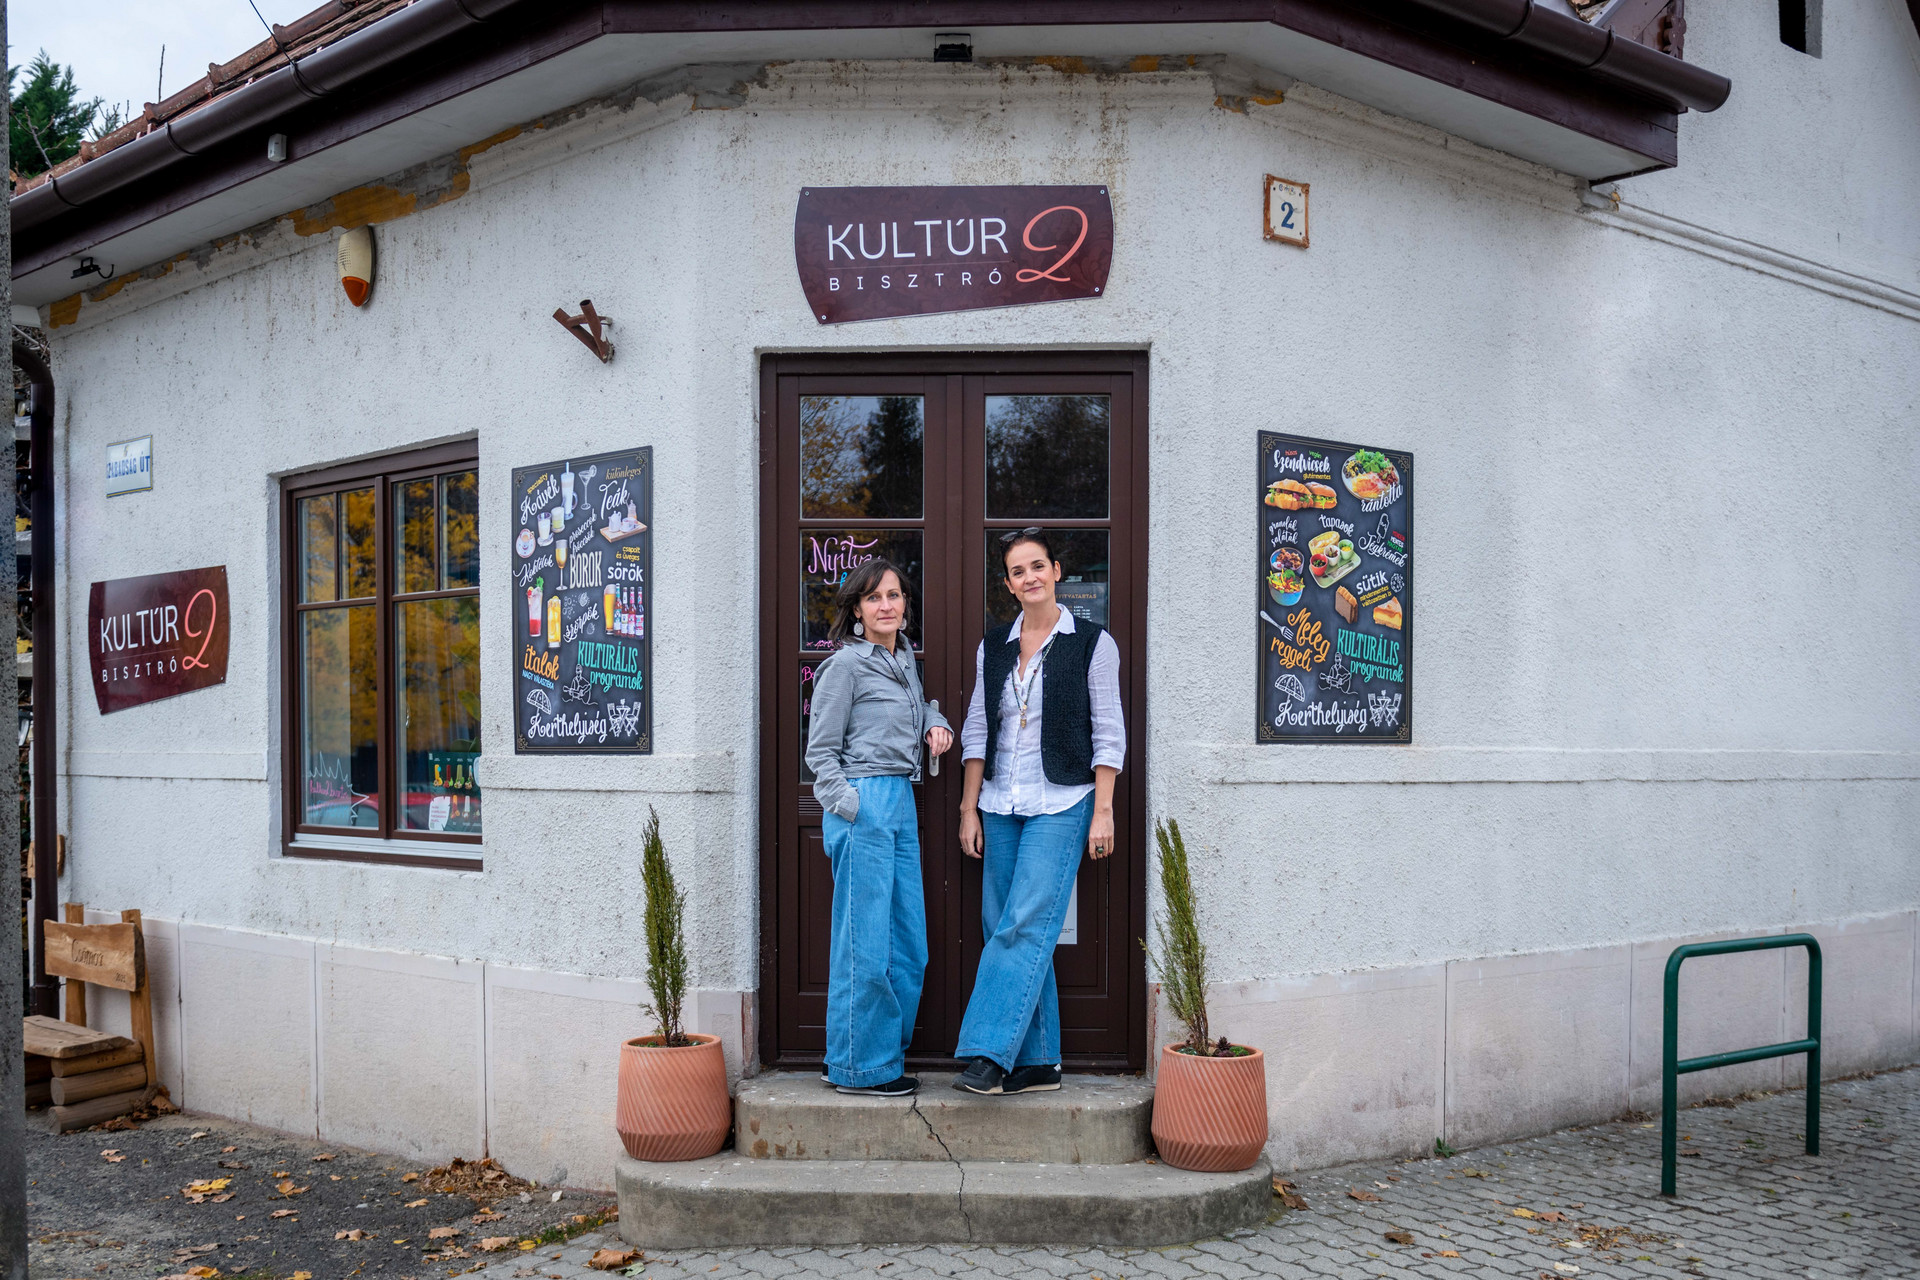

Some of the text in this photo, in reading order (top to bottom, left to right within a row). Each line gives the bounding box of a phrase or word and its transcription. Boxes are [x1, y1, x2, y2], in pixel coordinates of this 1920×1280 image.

[1281, 201, 1295, 230] 2
[827, 205, 1089, 284] KULTÚR 2
[828, 267, 1002, 292] BISZTRÓ
[139, 451, 151, 473] ÚT
[605, 465, 642, 481] különleges
[1273, 449, 1331, 474] Szendvicsek
[520, 473, 560, 526] Kávék
[598, 478, 631, 520] Teák
[1360, 482, 1404, 513] rántotta
[1268, 516, 1298, 535] granolák
[1271, 530, 1299, 548] saláták
[1318, 514, 1355, 537] tapasok
[1358, 532, 1408, 568] Jégkrémek
[512, 554, 554, 588] Koktélok
[569, 550, 603, 590] BOROK
[607, 561, 644, 582] sörök
[1356, 570, 1389, 595] sütik
[100, 588, 217, 671] KULTÚR 2
[562, 602, 600, 644] szörpök
[1287, 607, 1331, 664] Meleg
[523, 643, 560, 681] italok
[577, 640, 638, 674] KULTURÁLIS
[1270, 636, 1313, 673] reggeli
[1336, 628, 1400, 667] KULTURÁLIS
[102, 654, 177, 683] BISZTRÓ
[589, 670, 644, 693] programok
[1349, 660, 1404, 683] programok
[527, 710, 608, 744] Kerthelyiség
[1274, 699, 1368, 734] Kerthelyiség
